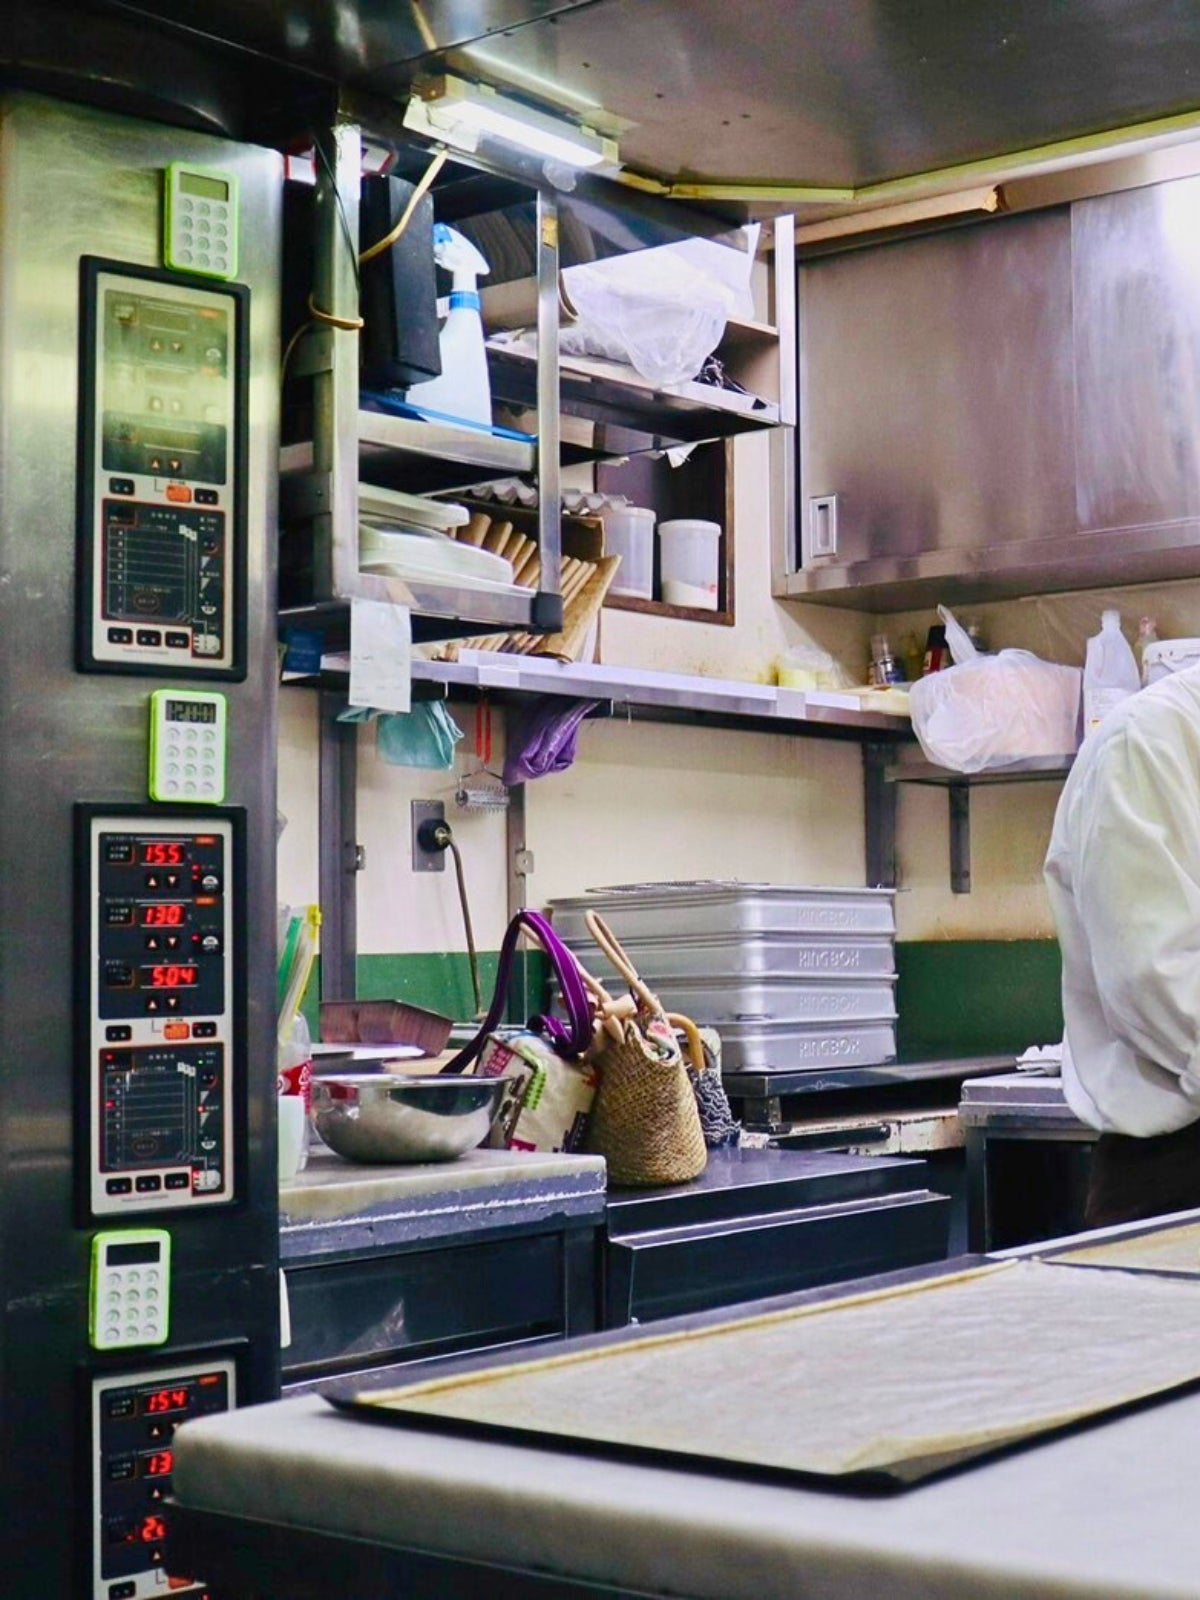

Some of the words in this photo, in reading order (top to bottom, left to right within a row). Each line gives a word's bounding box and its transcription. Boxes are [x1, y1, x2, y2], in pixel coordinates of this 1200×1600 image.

[145, 844, 181, 863] 155
[146, 905, 182, 924] 130
[799, 949, 860, 967] KINGBOX
[152, 966, 194, 986] 504
[799, 1039, 860, 1058] KINGBOX
[149, 1389, 185, 1412] 154
[149, 1451, 173, 1474] 13
